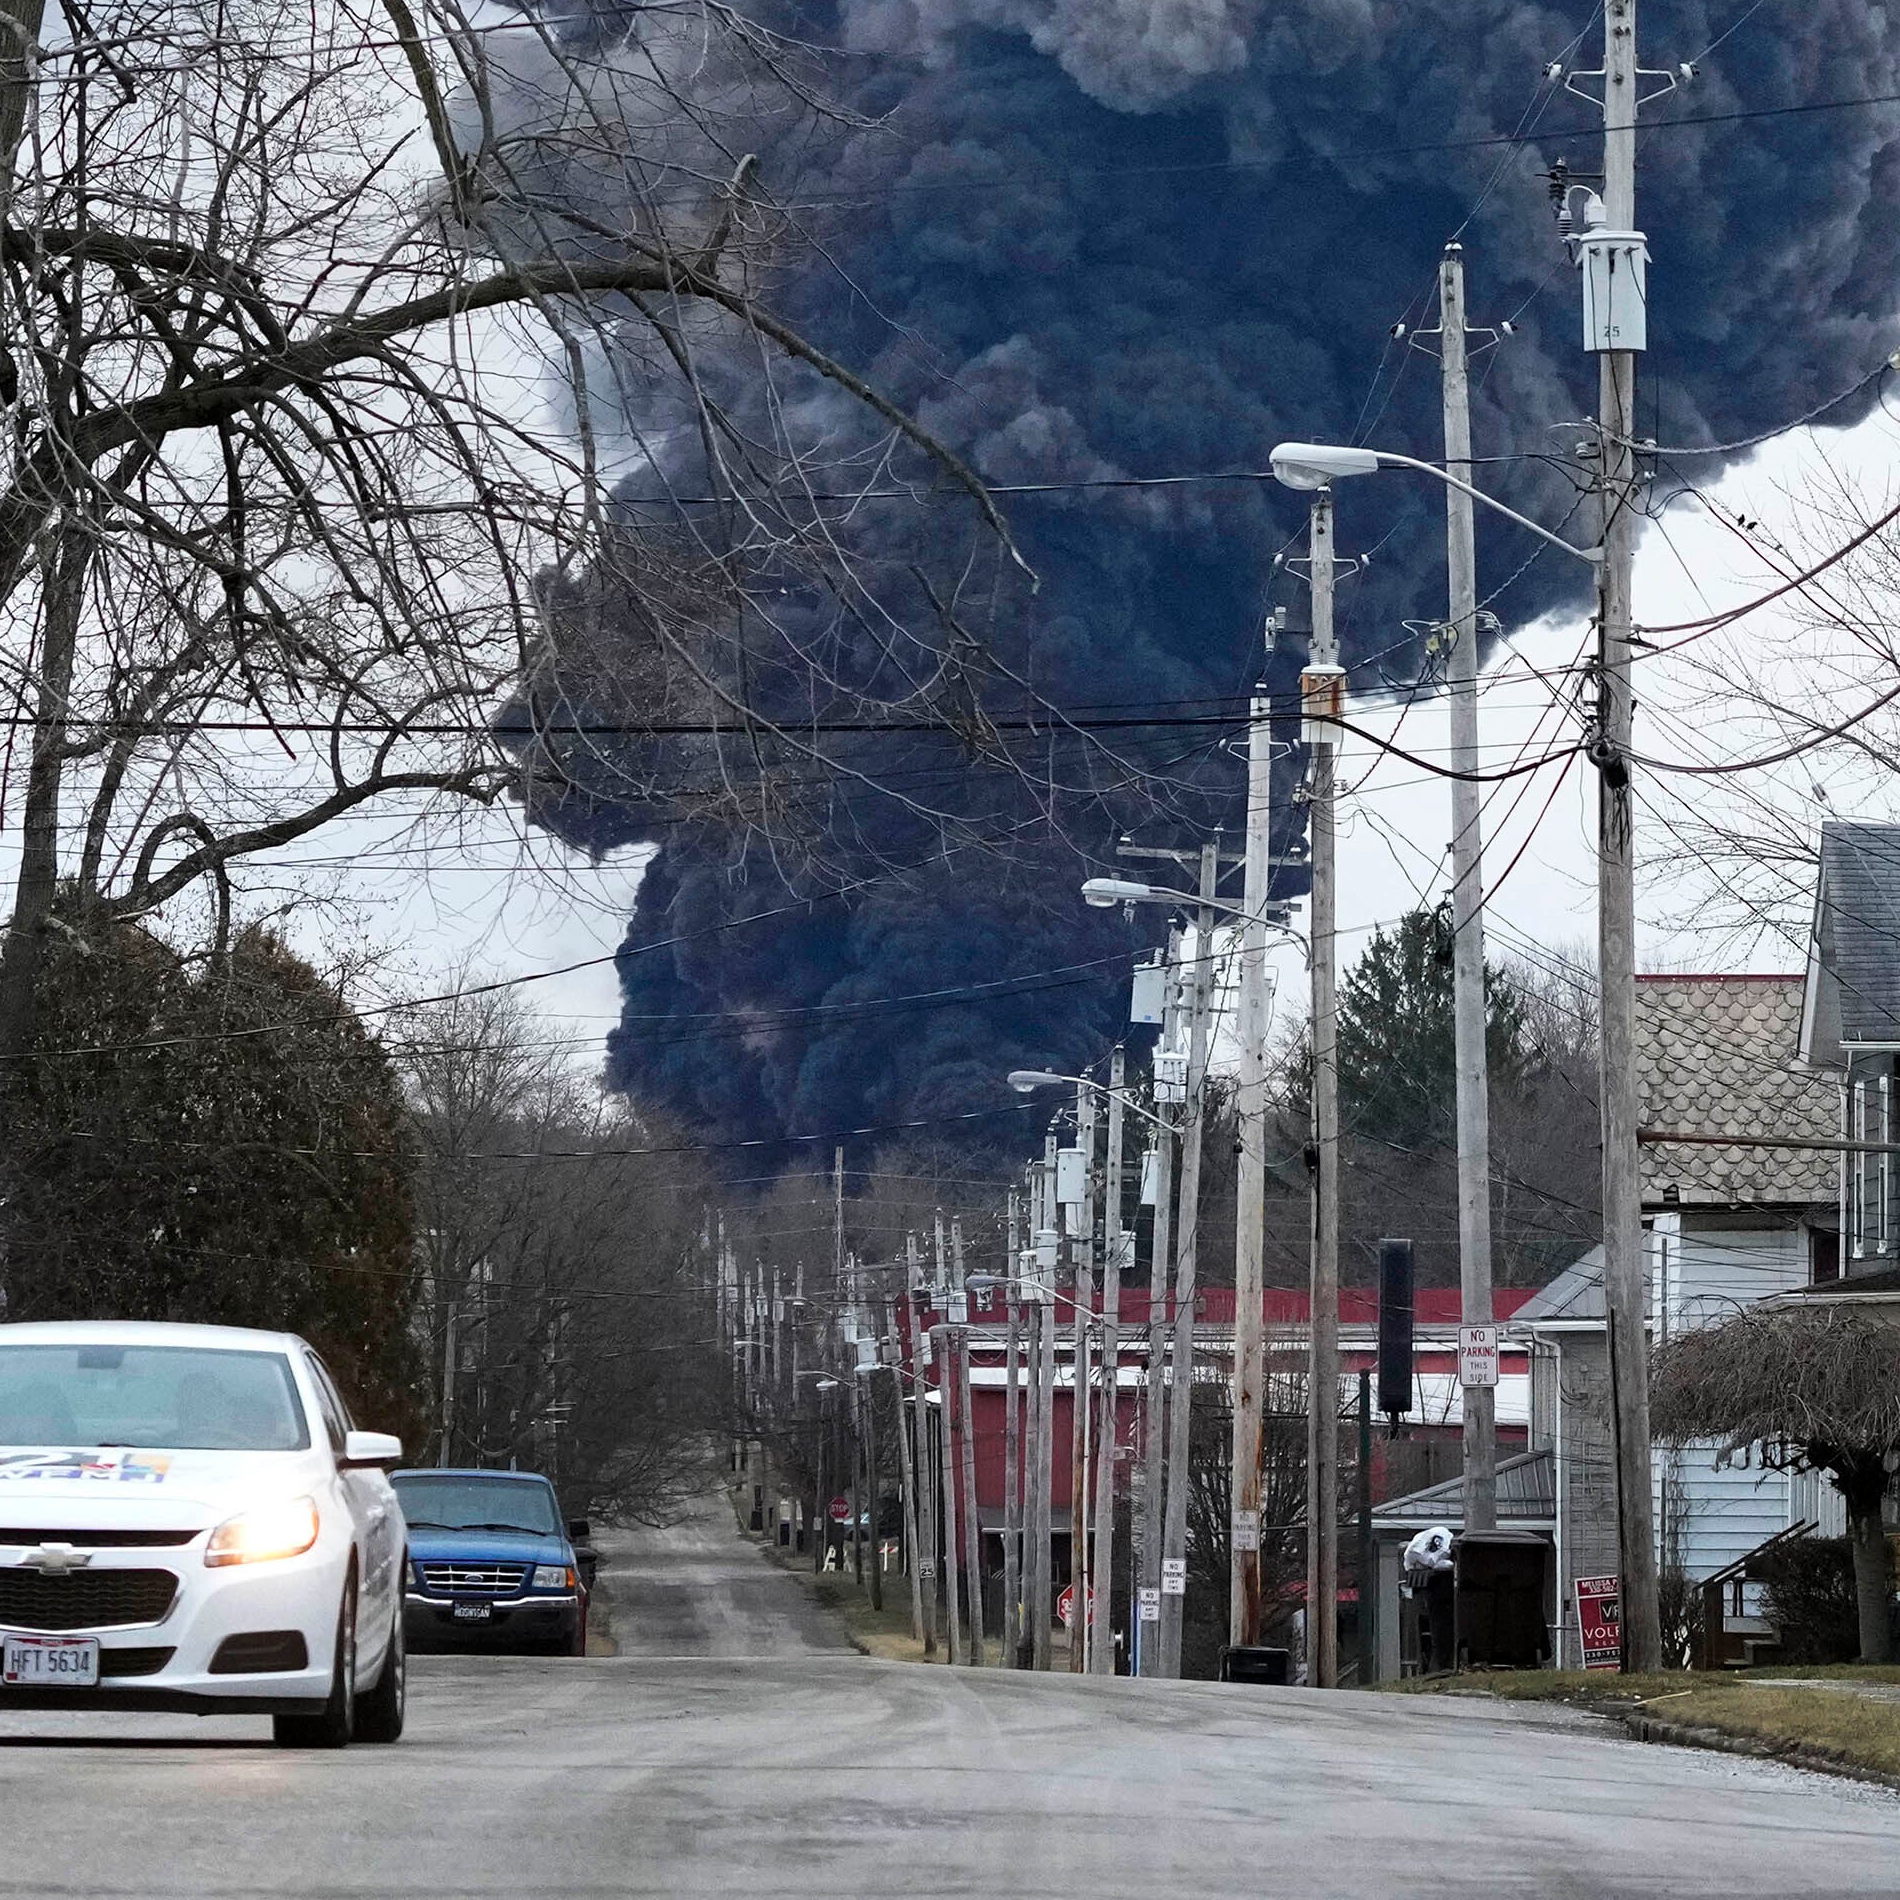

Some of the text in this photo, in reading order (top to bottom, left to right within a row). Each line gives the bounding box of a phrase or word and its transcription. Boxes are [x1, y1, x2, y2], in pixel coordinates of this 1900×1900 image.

[1604, 325, 1620, 338] 25
[1470, 1330, 1486, 1342] NO
[1461, 1346, 1496, 1358] PARKING
[1470, 1361, 1488, 1370] THIS
[1469, 1373, 1488, 1382] SIDE
[831, 1504, 849, 1513] STOP
[920, 1567, 934, 1577] 25
[11, 1650, 89, 1672] HFT 5634
